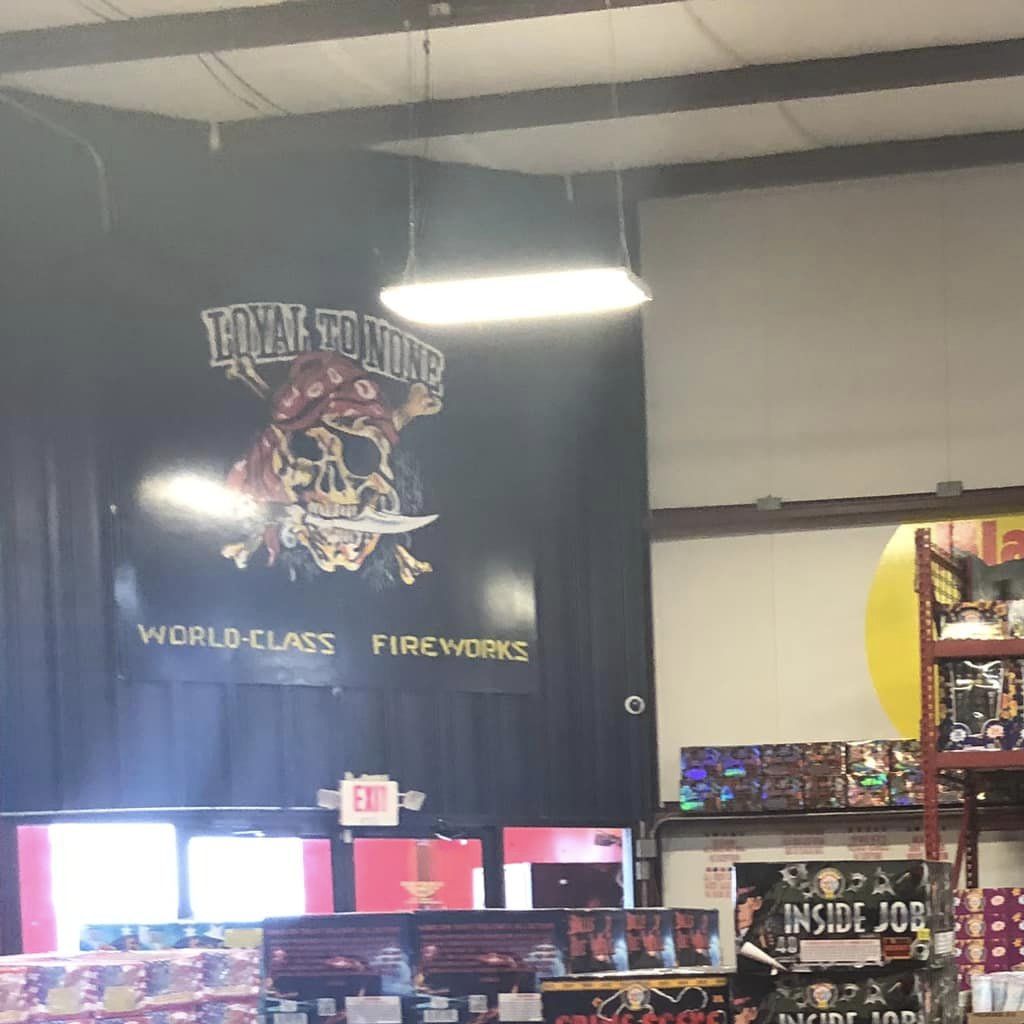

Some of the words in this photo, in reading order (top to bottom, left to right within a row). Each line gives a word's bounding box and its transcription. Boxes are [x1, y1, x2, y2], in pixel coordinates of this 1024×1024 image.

[315, 308, 358, 359] TO
[362, 314, 444, 397] NONE
[138, 623, 336, 655] WORLD-CLASS
[371, 633, 529, 662] FIREWORKS
[353, 785, 387, 811] EXIT
[784, 902, 866, 935] INSIDE
[873, 901, 926, 933] JOB
